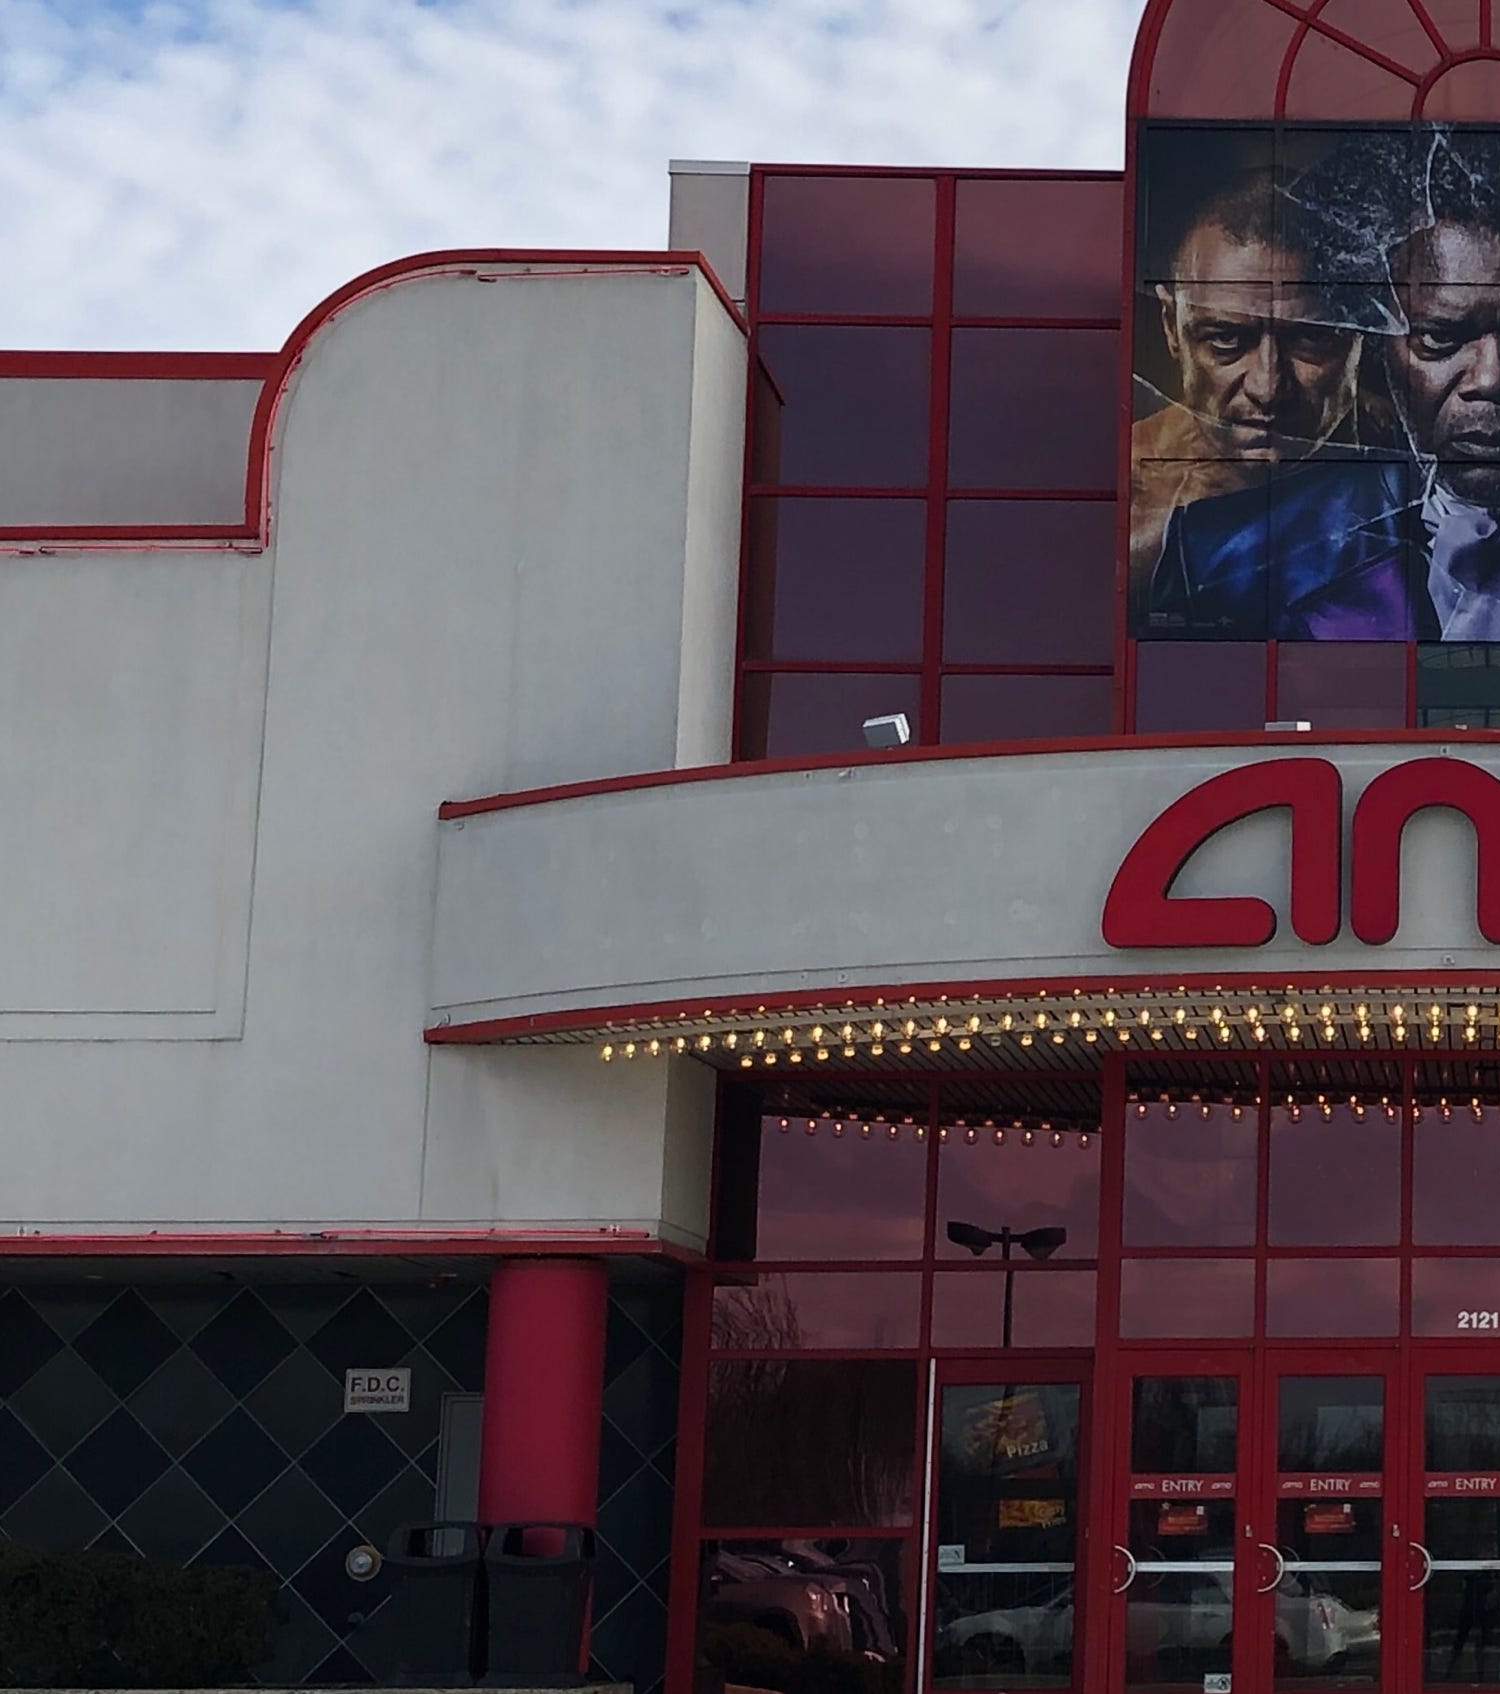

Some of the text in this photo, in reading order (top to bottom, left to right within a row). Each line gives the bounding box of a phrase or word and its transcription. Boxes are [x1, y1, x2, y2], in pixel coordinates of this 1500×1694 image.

[1457, 1310, 1499, 1329] 2121
[350, 1375, 404, 1392] F.D.C.
[1162, 1480, 1204, 1492] ENTRY
[1310, 1479, 1352, 1491] ENTRY
[1455, 1478, 1497, 1490] ENTRY
